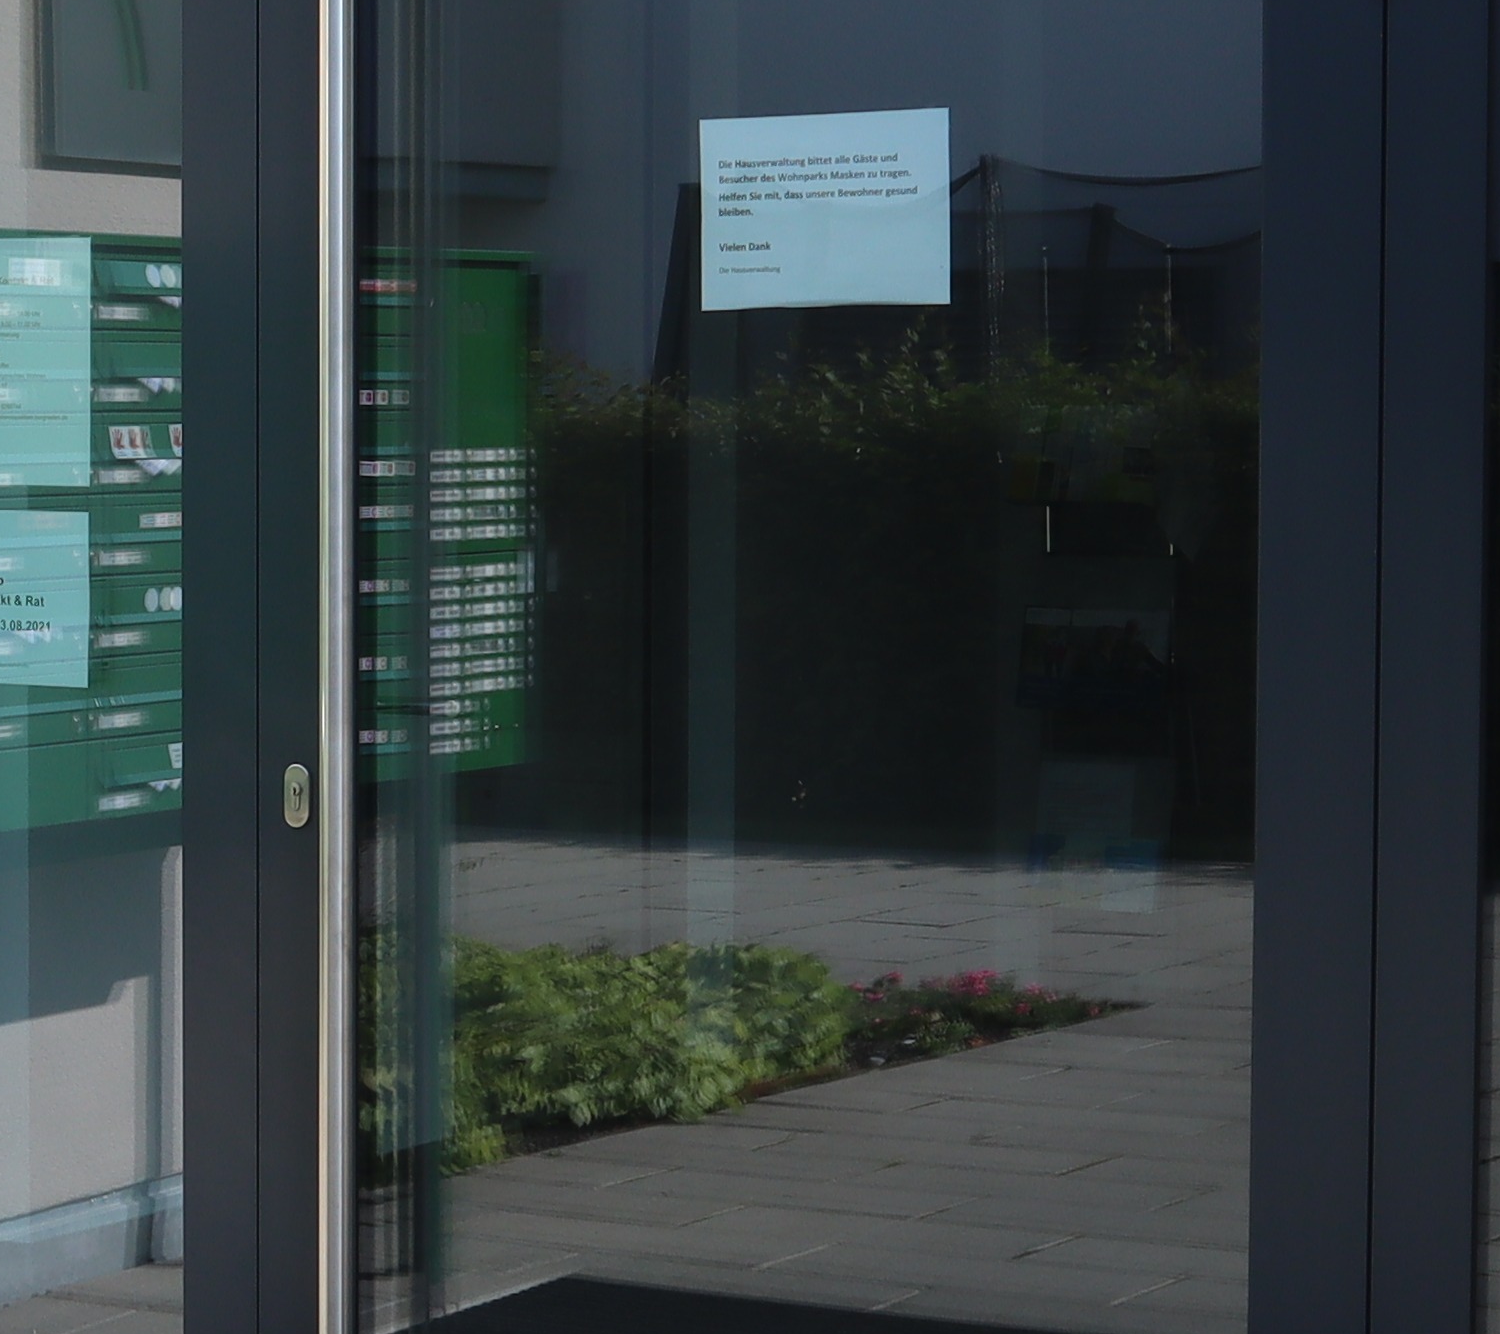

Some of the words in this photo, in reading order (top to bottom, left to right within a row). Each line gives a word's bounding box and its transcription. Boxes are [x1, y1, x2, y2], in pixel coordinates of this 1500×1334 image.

[718, 160, 732, 168] Die
[735, 158, 805, 168] Hausverwaltung
[808, 156, 832, 165] bittet
[834, 155, 851, 164] alle
[853, 154, 878, 163] Gäste
[880, 154, 898, 162] und
[719, 175, 758, 184] Besucher
[760, 174, 776, 182] des
[778, 172, 828, 182] Wohnparks
[830, 171, 865, 179] Masken
[880, 169, 912, 179] tragen.
[719, 193, 747, 202] Helfen
[749, 192, 762, 200] Sie
[764, 191, 782, 201] mit,
[784, 191, 803, 199] dass
[806, 190, 835, 199] unsere
[838, 188, 883, 197] Bewohner
[885, 186, 918, 197] gesund
[718, 208, 754, 217] bleiben.
[719, 243, 746, 252] Vielen
[749, 242, 771, 251] Dank
[14, 595, 22, 606] &
[25, 596, 45, 607] Rat
